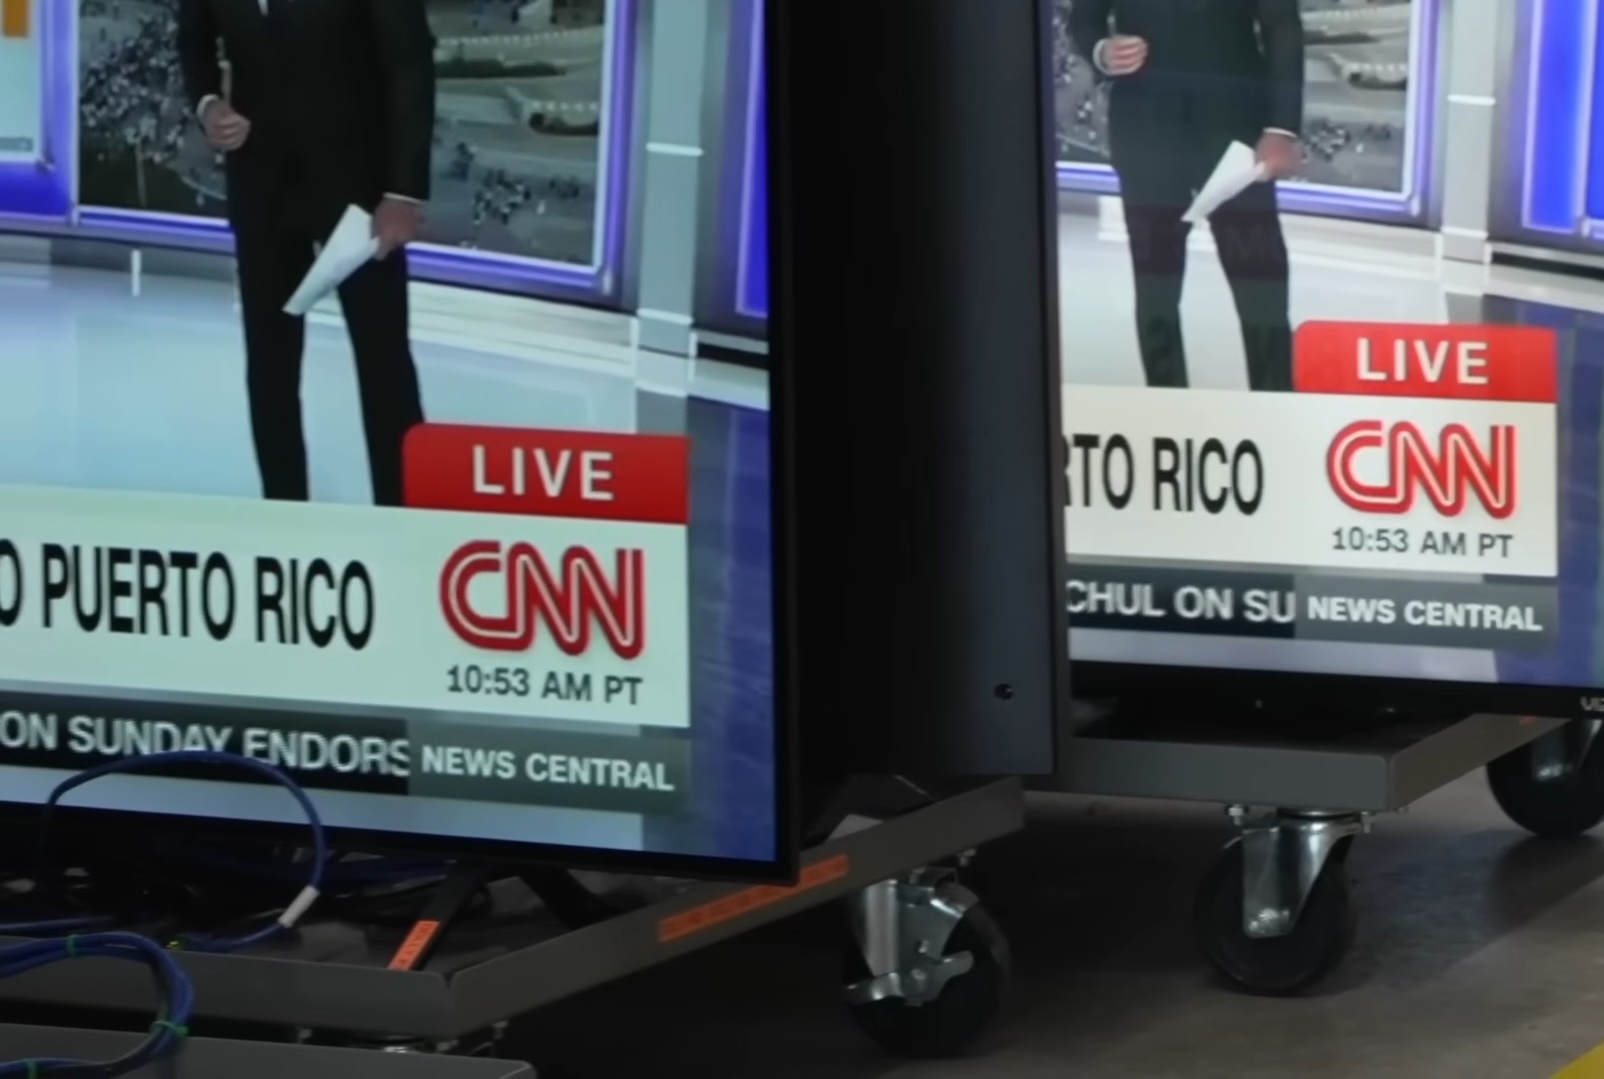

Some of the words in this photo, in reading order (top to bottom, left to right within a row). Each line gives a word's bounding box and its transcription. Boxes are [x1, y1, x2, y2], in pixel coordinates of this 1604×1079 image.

[1356, 337, 1489, 384] LIVE
[471, 444, 616, 501] LIVE
[1152, 437, 1264, 516] RICO
[1325, 420, 1518, 519] CNN
[1332, 526, 1409, 553] 10:53
[1420, 531, 1466, 556] AM
[1478, 533, 1514, 558] PT
[42, 543, 236, 642] PUERTO
[255, 556, 375, 650] RICO
[438, 540, 646, 660] CNN
[1174, 585, 1234, 619] ON
[1243, 589, 1296, 623] SU
[1307, 595, 1396, 624] NEWS
[1404, 600, 1543, 632] CENTRAL
[447, 664, 530, 697] 10:53
[541, 671, 592, 701] AM
[604, 675, 643, 705] PT
[0, 711, 58, 750] ON
[68, 716, 231, 755] SUNDAY
[243, 727, 411, 777] ENDORS
[422, 745, 517, 779] NEWS
[525, 752, 675, 792] CENTRAL
